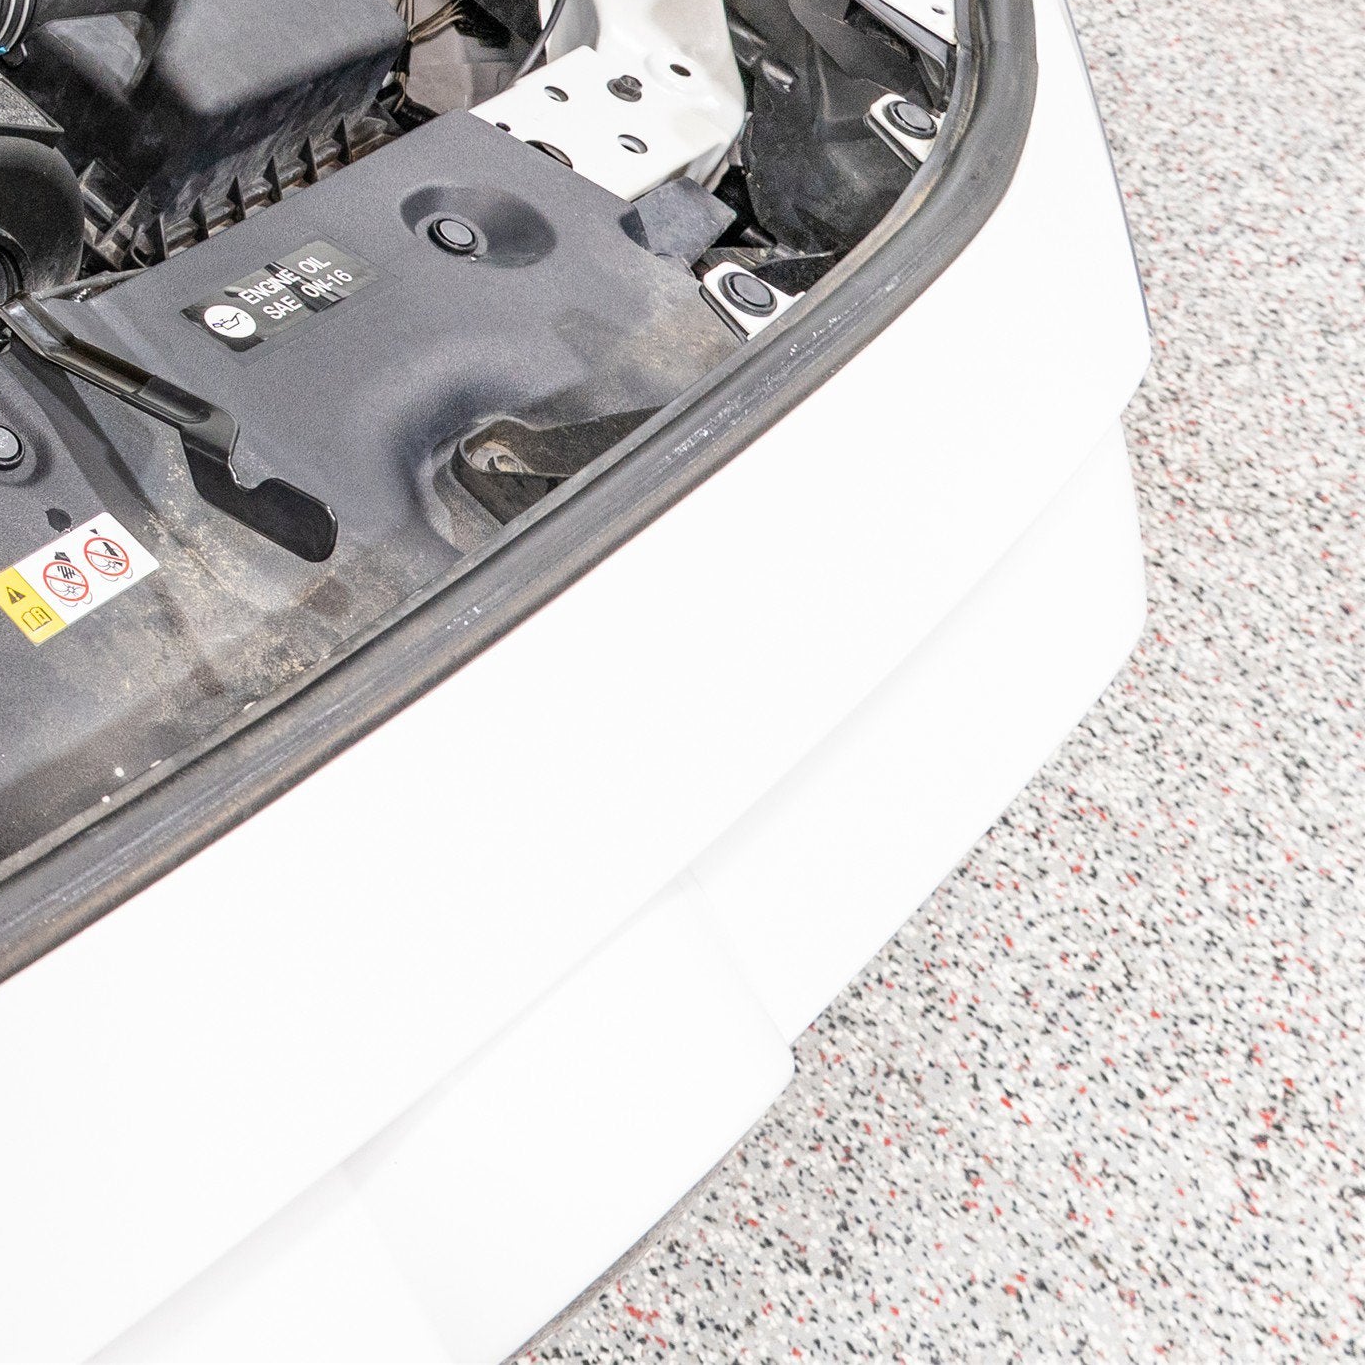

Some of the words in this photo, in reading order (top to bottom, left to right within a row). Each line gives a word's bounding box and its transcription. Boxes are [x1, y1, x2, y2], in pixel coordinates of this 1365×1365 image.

[238, 268, 301, 305] ENGINE
[298, 256, 332, 274] OIL
[262, 295, 303, 320] SAE
[301, 269, 353, 299] 0W-16
